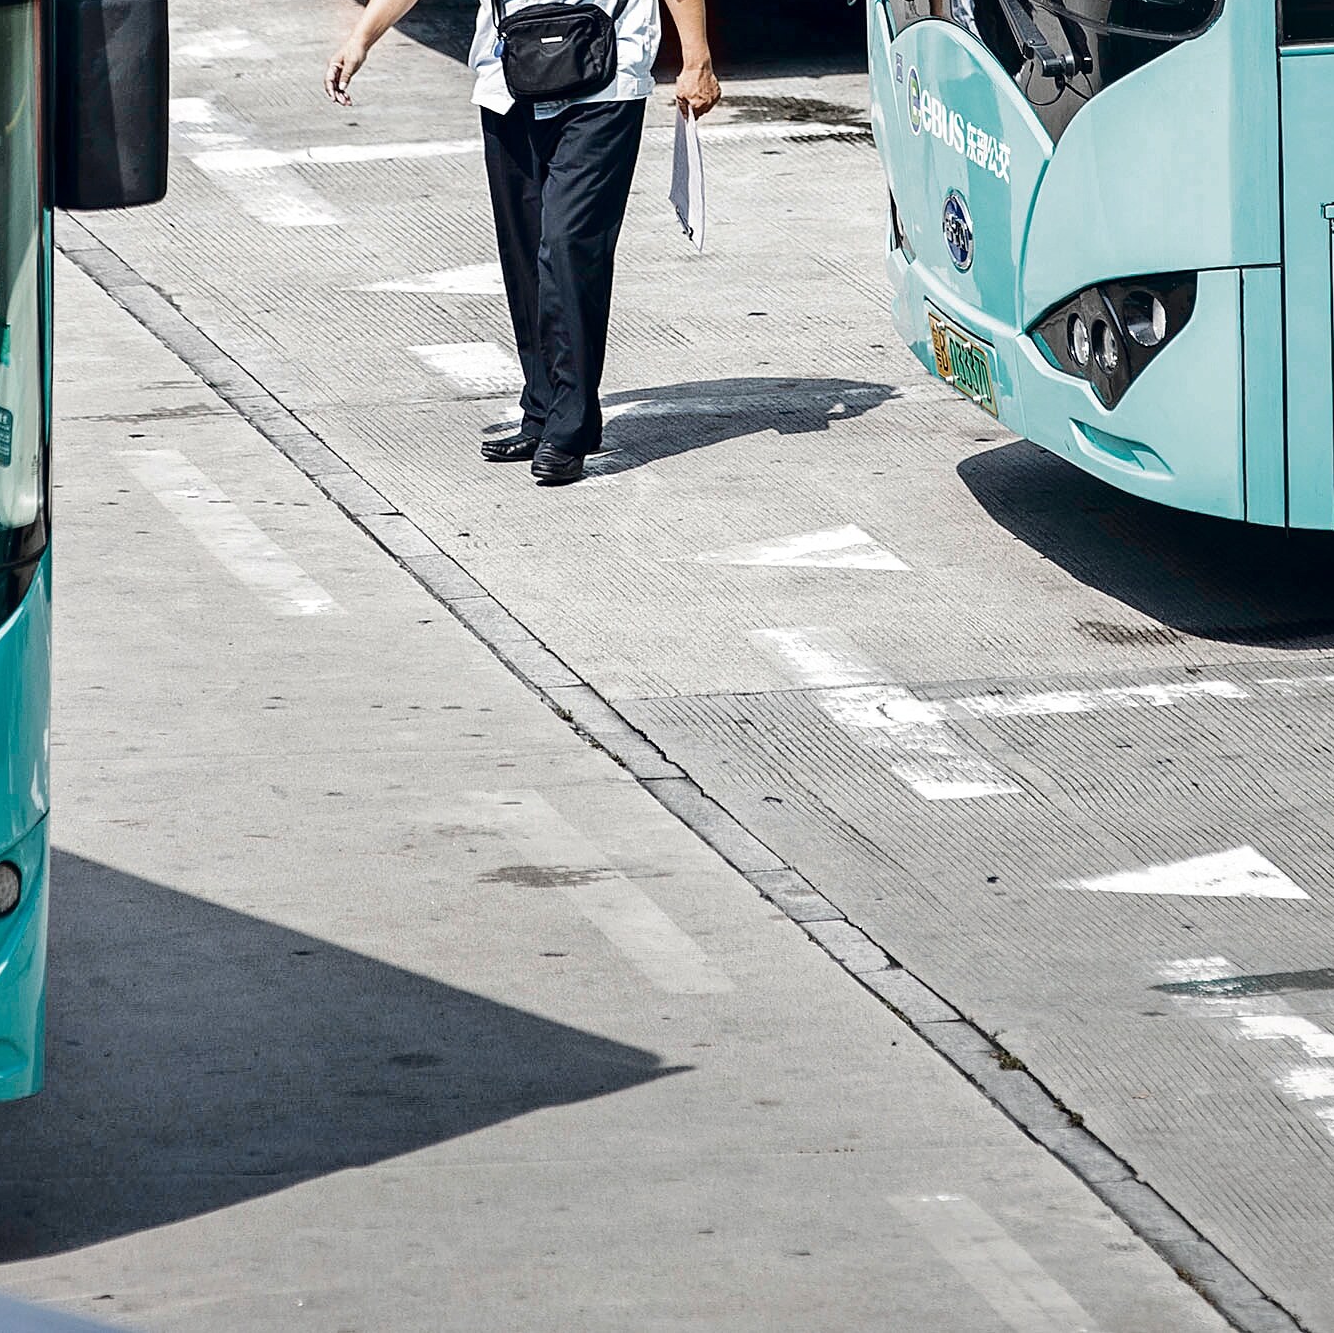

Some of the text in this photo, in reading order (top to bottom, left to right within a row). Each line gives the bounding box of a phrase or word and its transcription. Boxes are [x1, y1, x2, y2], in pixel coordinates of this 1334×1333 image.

[921, 89, 1011, 184] eBUS 东部公交
